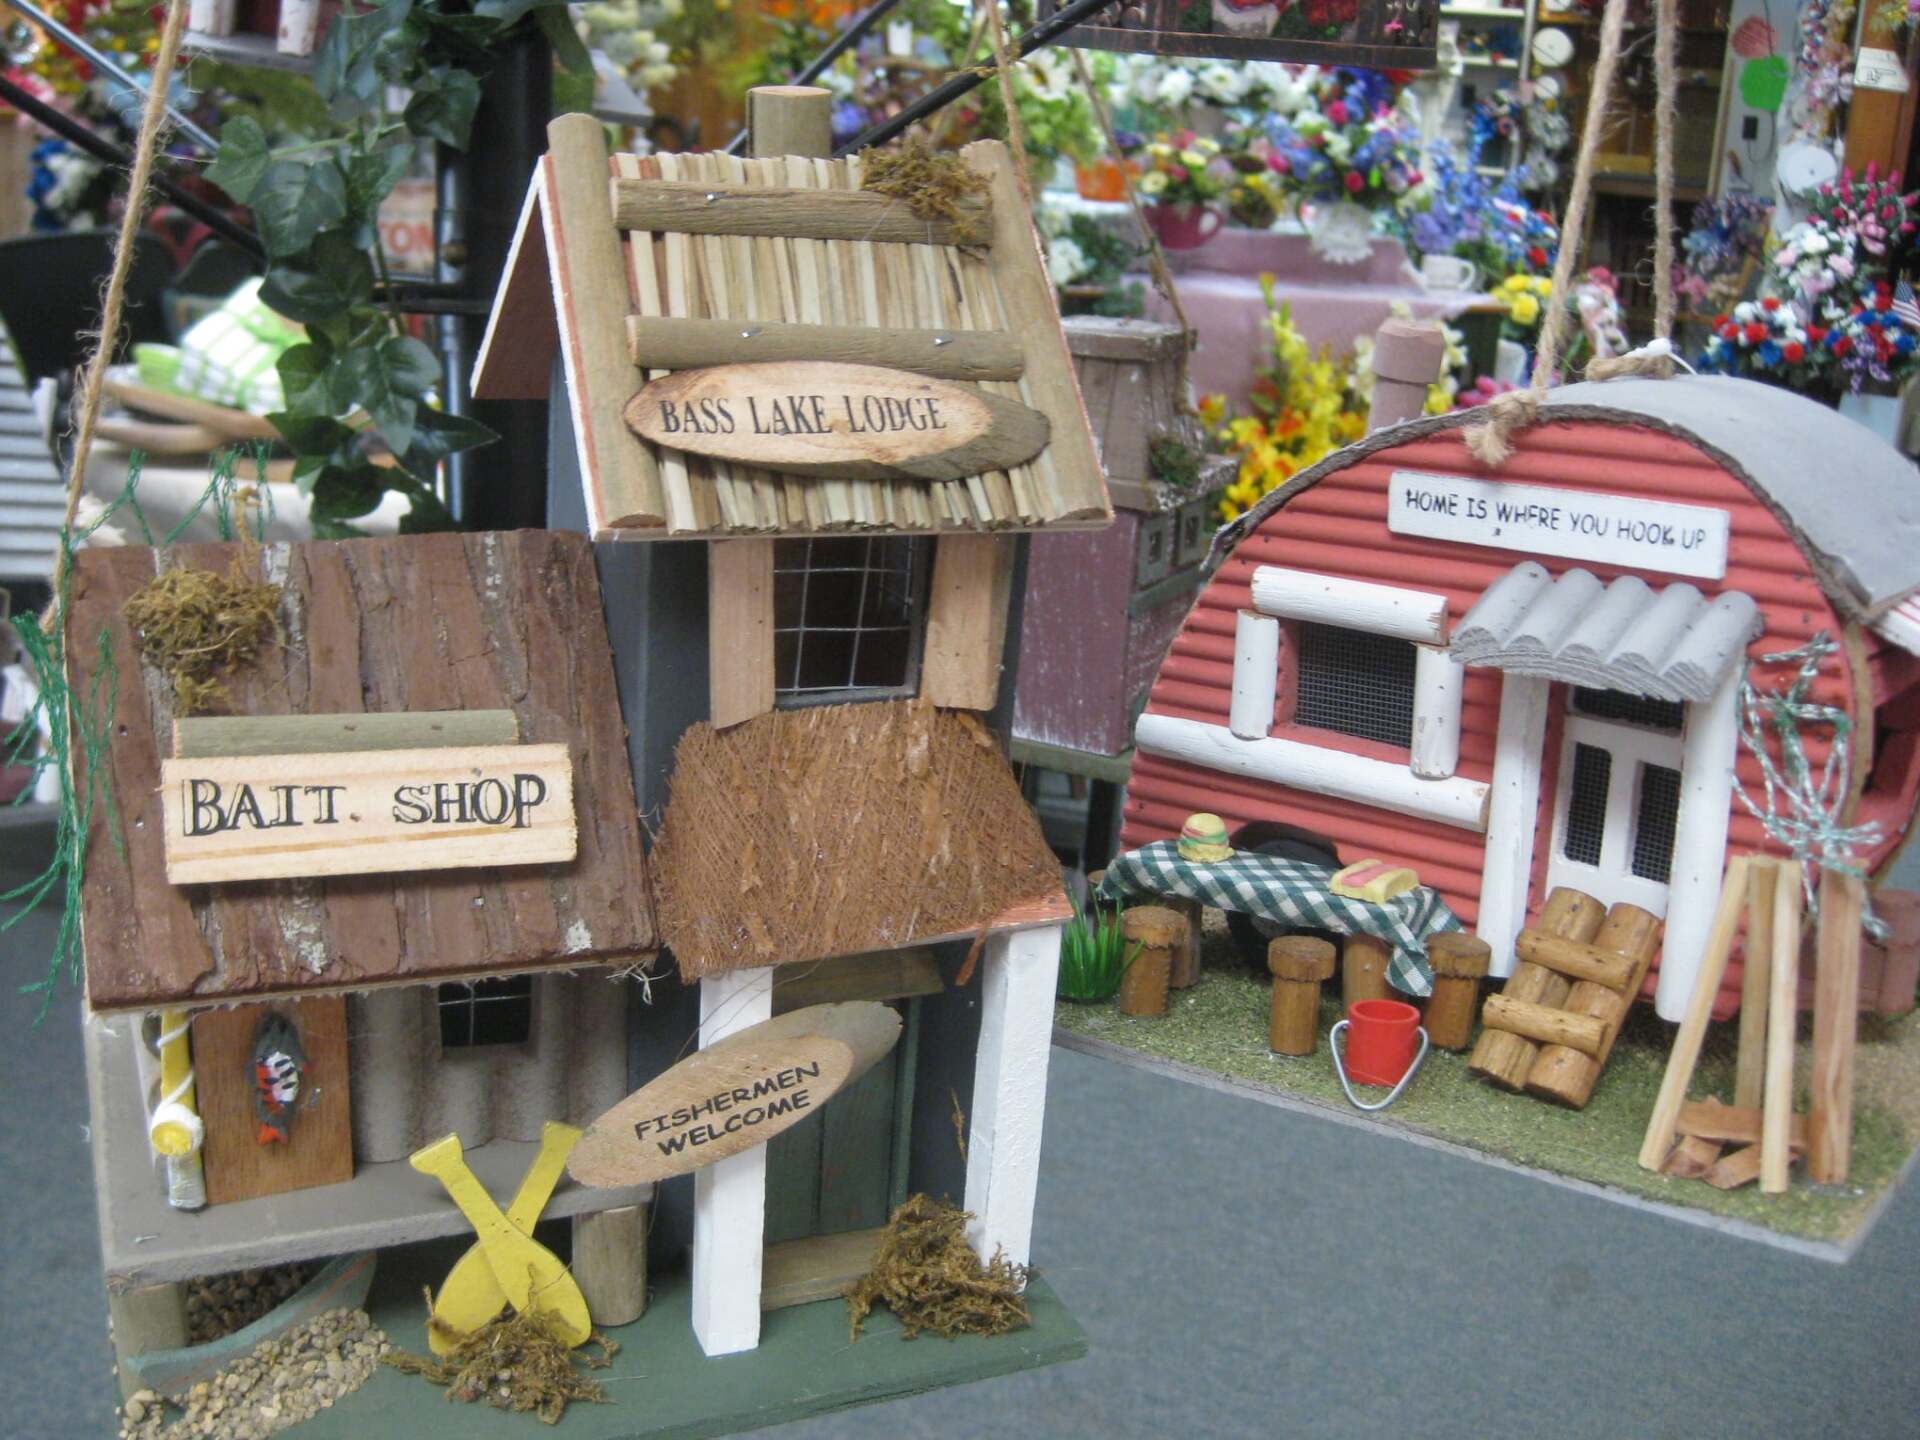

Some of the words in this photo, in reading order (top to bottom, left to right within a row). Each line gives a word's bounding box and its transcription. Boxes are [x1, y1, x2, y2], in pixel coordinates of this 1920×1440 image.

[659, 398, 736, 434] BASS
[746, 395, 832, 435] LAKE
[842, 395, 947, 433] LODGE
[1406, 488, 1458, 516] HOME
[1466, 497, 1488, 519] IS
[1496, 503, 1560, 530] WHERE
[1570, 511, 1609, 536] YOU
[1617, 519, 1675, 546] HOOK
[1681, 529, 1706, 549] UP
[182, 778, 346, 837] BAIT
[393, 773, 546, 829] SHOP
[634, 1061, 820, 1140] FISHERMEN
[656, 1089, 811, 1156] WELCOME
